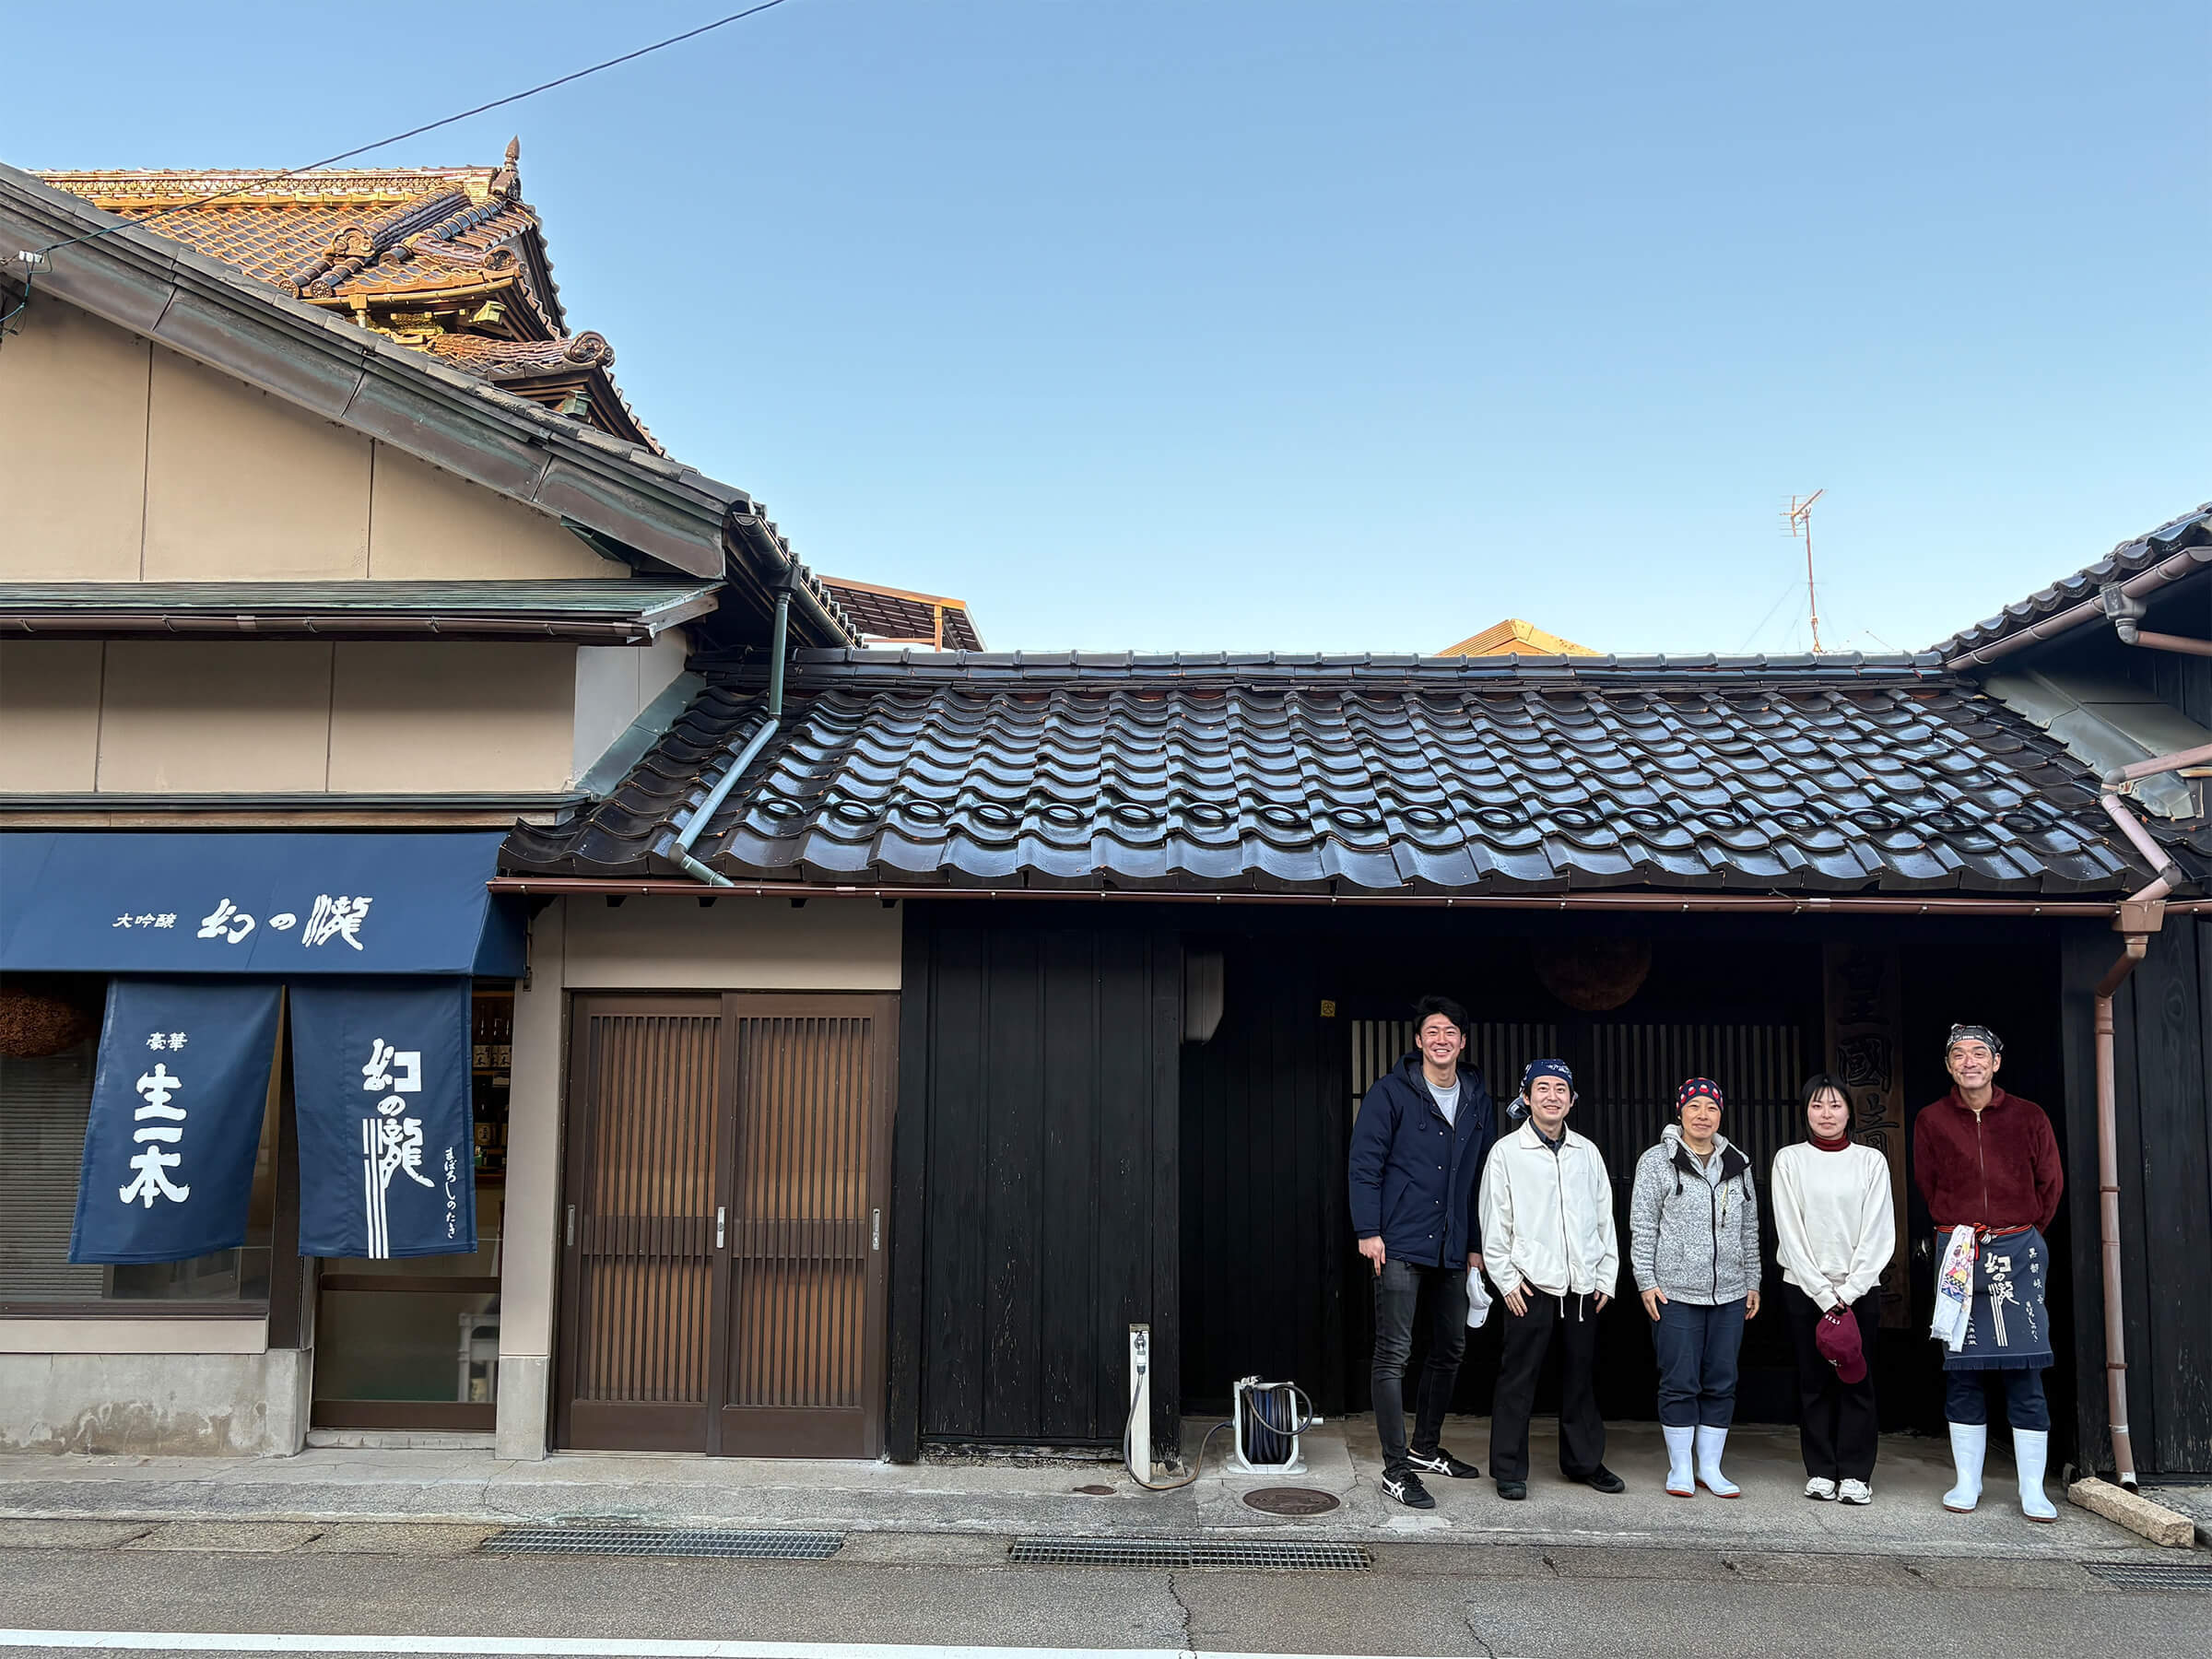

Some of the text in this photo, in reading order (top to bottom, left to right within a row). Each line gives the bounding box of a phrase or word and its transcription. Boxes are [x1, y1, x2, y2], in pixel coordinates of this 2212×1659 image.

[112, 912, 178, 929] 大吟醸
[196, 893, 373, 951] 幻の瀧
[146, 1031, 188, 1052] 豪華
[119, 1063, 191, 1209] 生一本
[361, 1038, 435, 1259] 幻の瀧
[443, 1147, 458, 1240] まぼろしのたき
